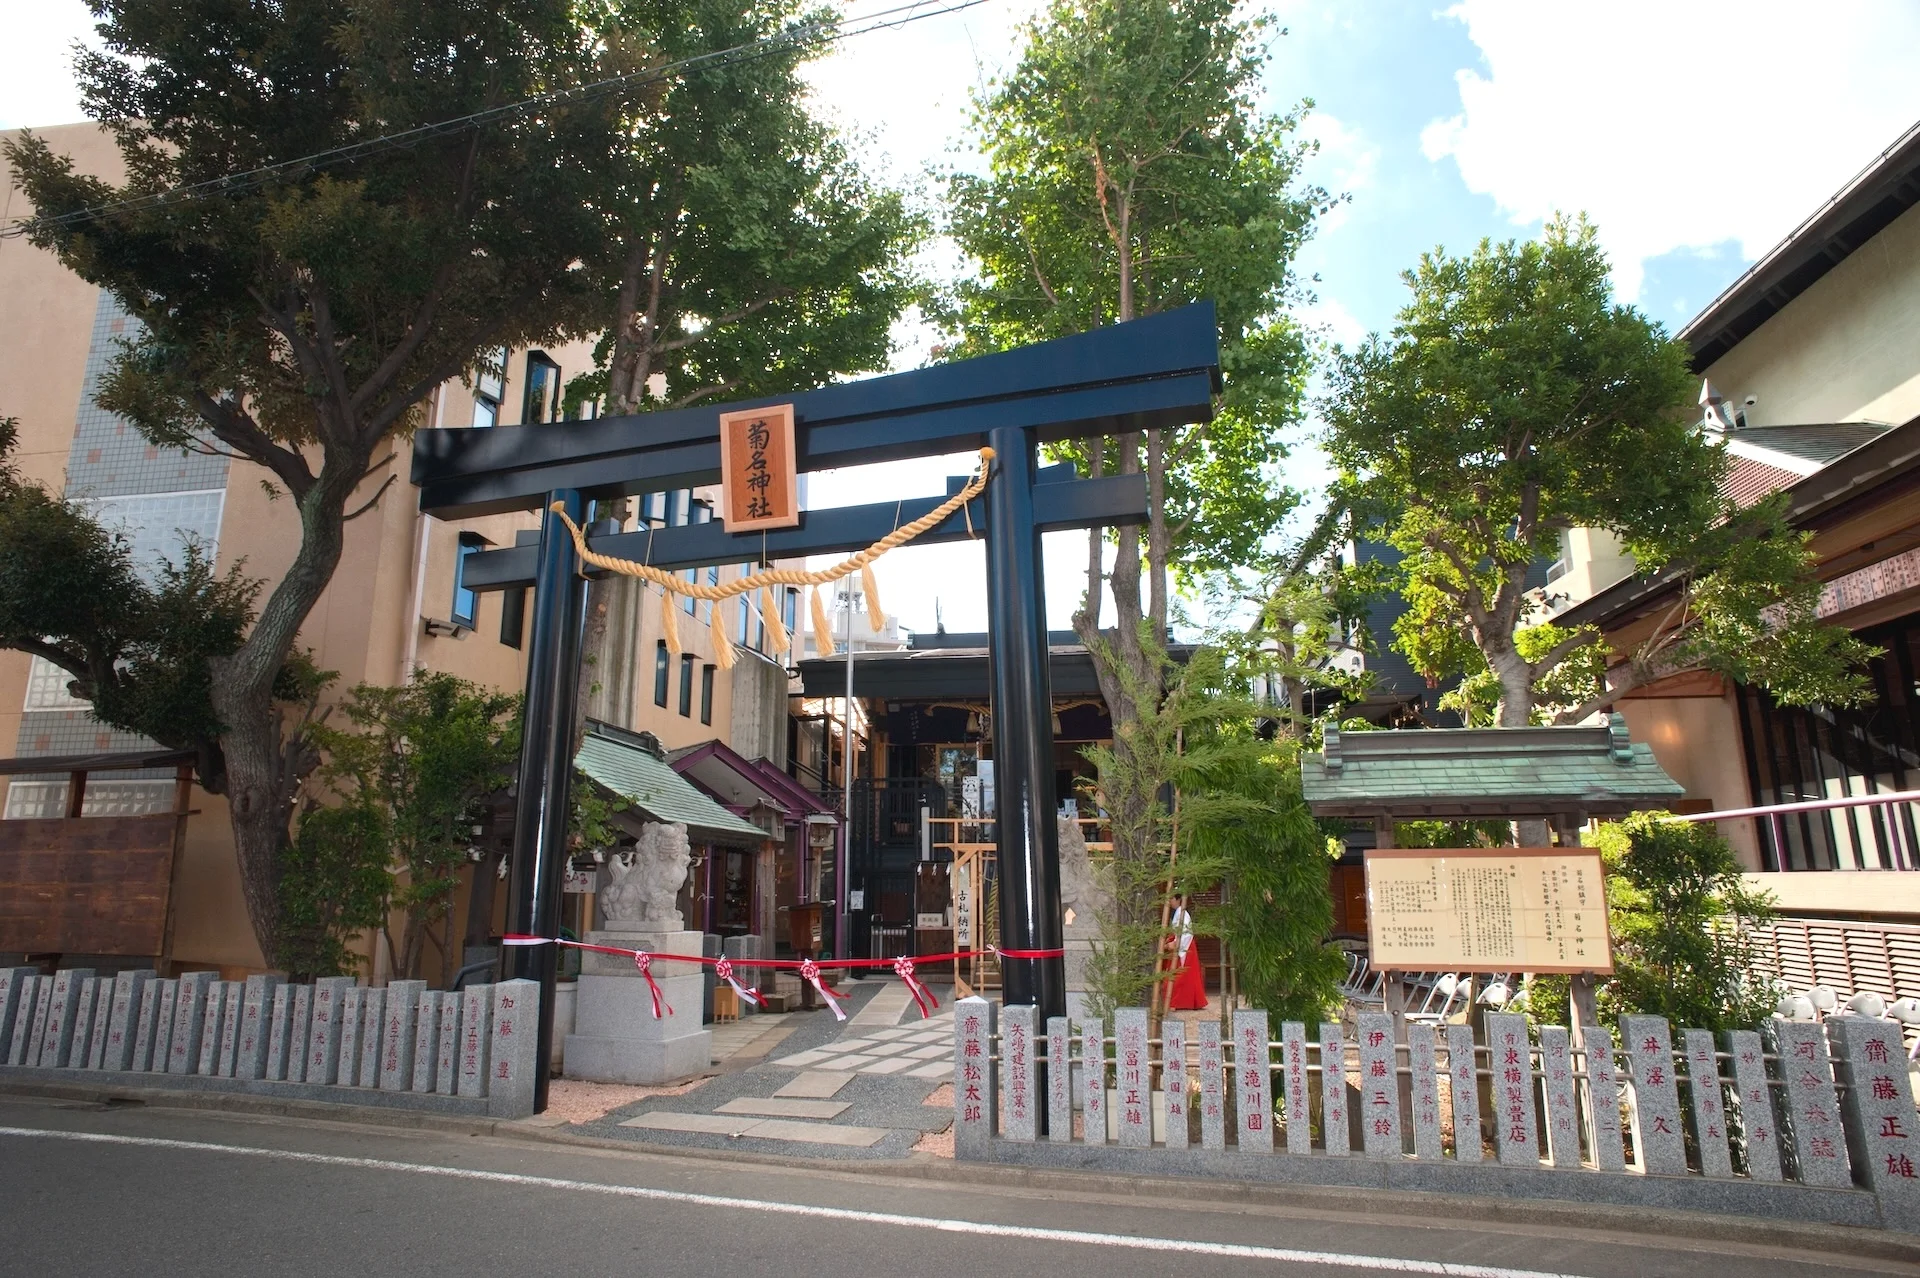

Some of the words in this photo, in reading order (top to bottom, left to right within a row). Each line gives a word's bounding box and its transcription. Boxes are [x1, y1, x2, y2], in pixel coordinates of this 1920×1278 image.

[744, 420, 772, 518] 菊名神社
[957, 890, 969, 940] 古札納所
[313, 989, 330, 1065] 福地光男
[418, 1004, 429, 1065] 石川正人
[1053, 1035, 1065, 1108] 妙蓮寺レンタカー
[1087, 1035, 1100, 1111] 金子光男
[1204, 1039, 1218, 1116] 畑野三郎
[1290, 1040, 1304, 1120] 菊名東口商栄会
[1327, 1042, 1342, 1121] 石井清秀
[1368, 1031, 1392, 1136] 伊藤三鈴
[1551, 1046, 1571, 1130] 河野義則
[1742, 1052, 1768, 1142] 妙蓮寺
